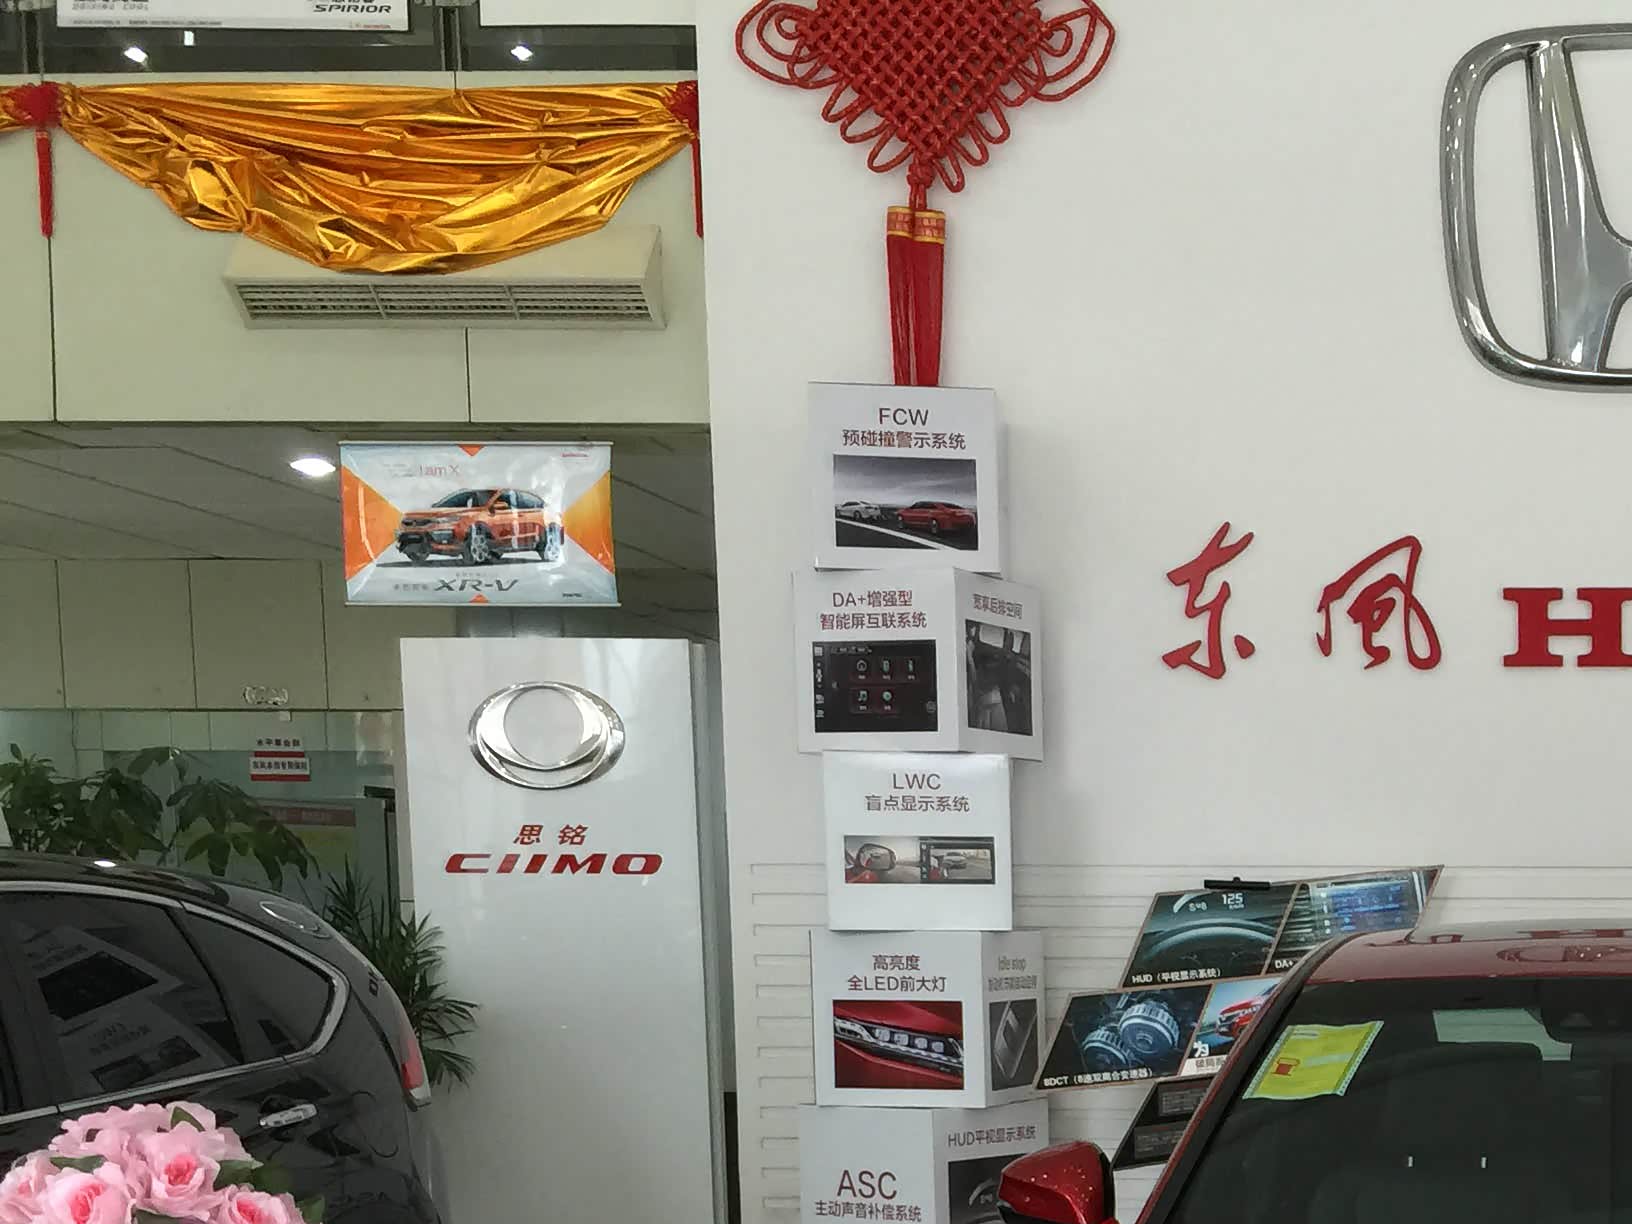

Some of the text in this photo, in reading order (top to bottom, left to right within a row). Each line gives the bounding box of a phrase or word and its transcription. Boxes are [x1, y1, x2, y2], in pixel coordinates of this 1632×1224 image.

[313, 4, 392, 13] SPIRIOR
[878, 408, 929, 426] FCW
[842, 430, 966, 450] 预碰撞警示系统
[434, 578, 519, 592] XR-V
[832, 590, 913, 608] DA+增强型
[820, 612, 927, 630] 智能屏互联系统
[892, 772, 941, 790] LWC
[865, 795, 970, 813] 盲点显示系统
[512, 824, 588, 846] 思铭
[445, 853, 663, 875] CIIMO
[1222, 893, 1243, 905] 125
[872, 955, 920, 971] 高亮度
[848, 975, 947, 993] 全LED前大灯
[948, 1124, 1037, 1148] HUD平视显示系统
[836, 1169, 897, 1200] ASC
[815, 1200, 922, 1223] 主动声音补偿系统
